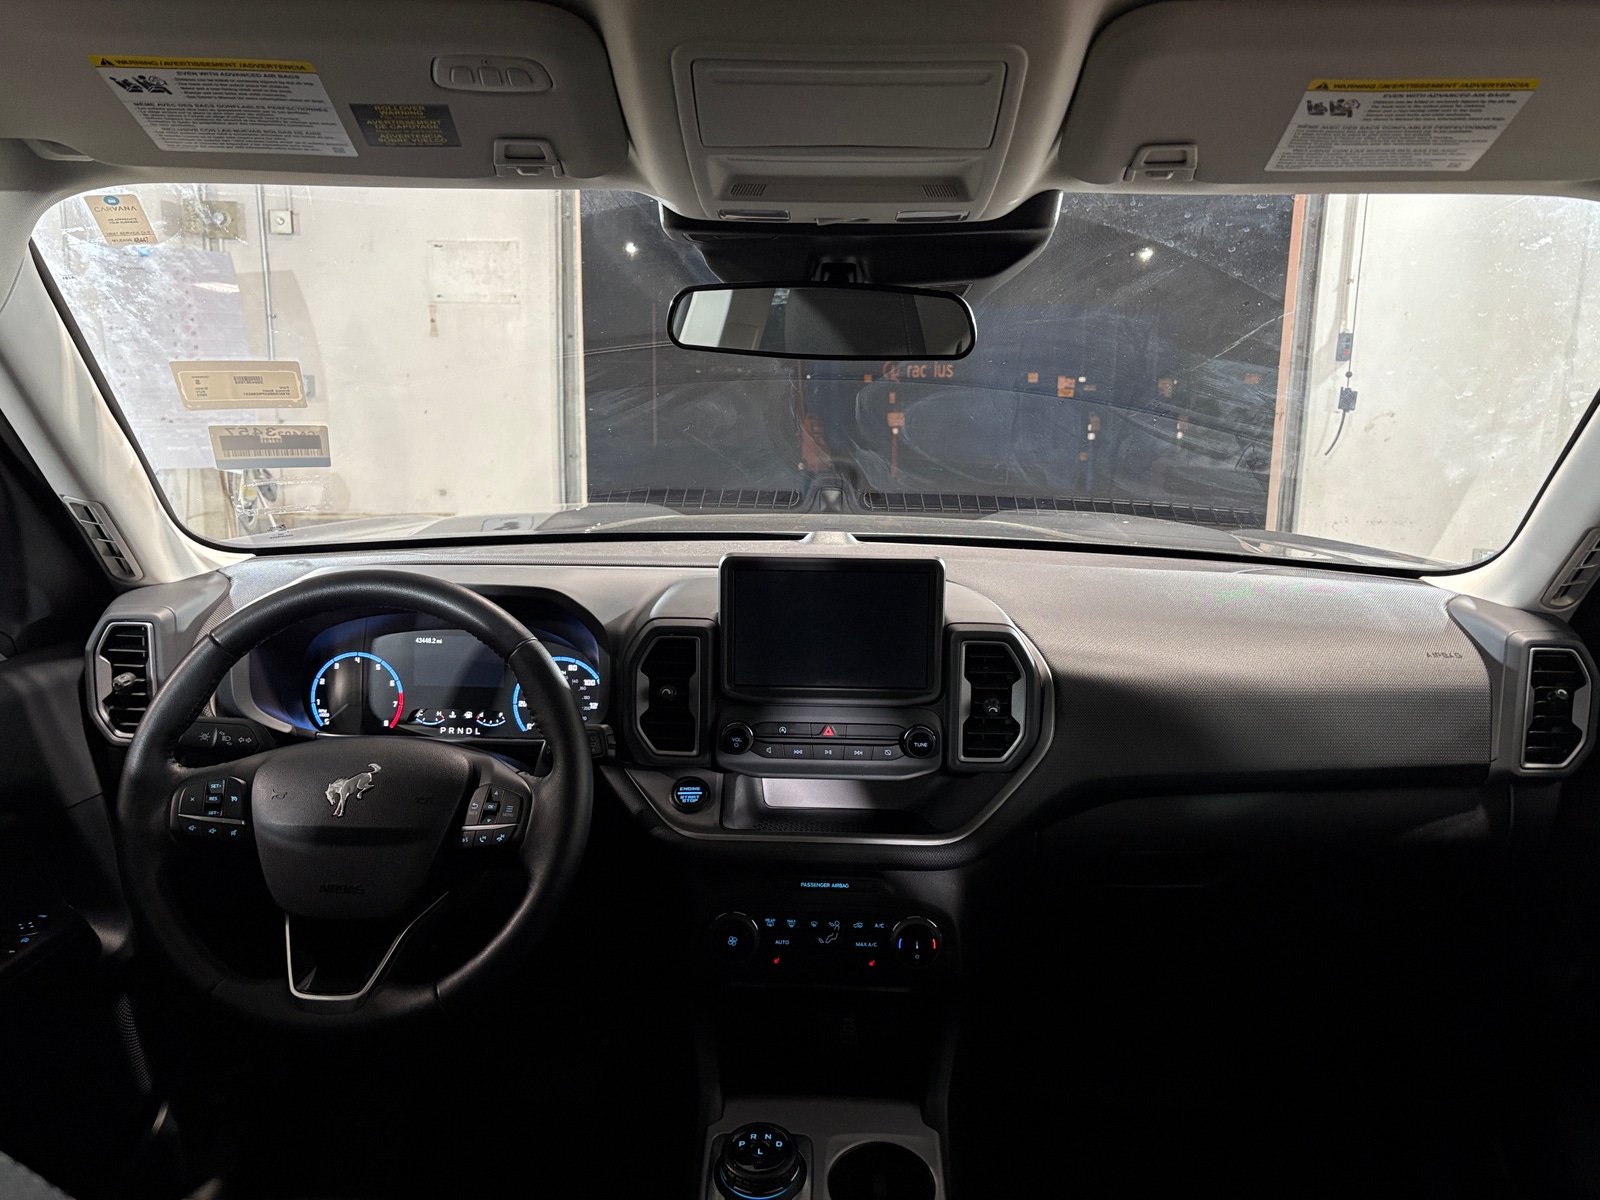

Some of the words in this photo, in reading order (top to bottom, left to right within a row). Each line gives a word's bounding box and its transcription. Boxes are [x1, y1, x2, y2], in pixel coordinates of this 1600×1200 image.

[114, 59, 159, 67] WARNING
[354, 656, 361, 664] 4
[584, 678, 597, 687] 100
[316, 698, 321, 706] 1
[392, 700, 399, 708] 7
